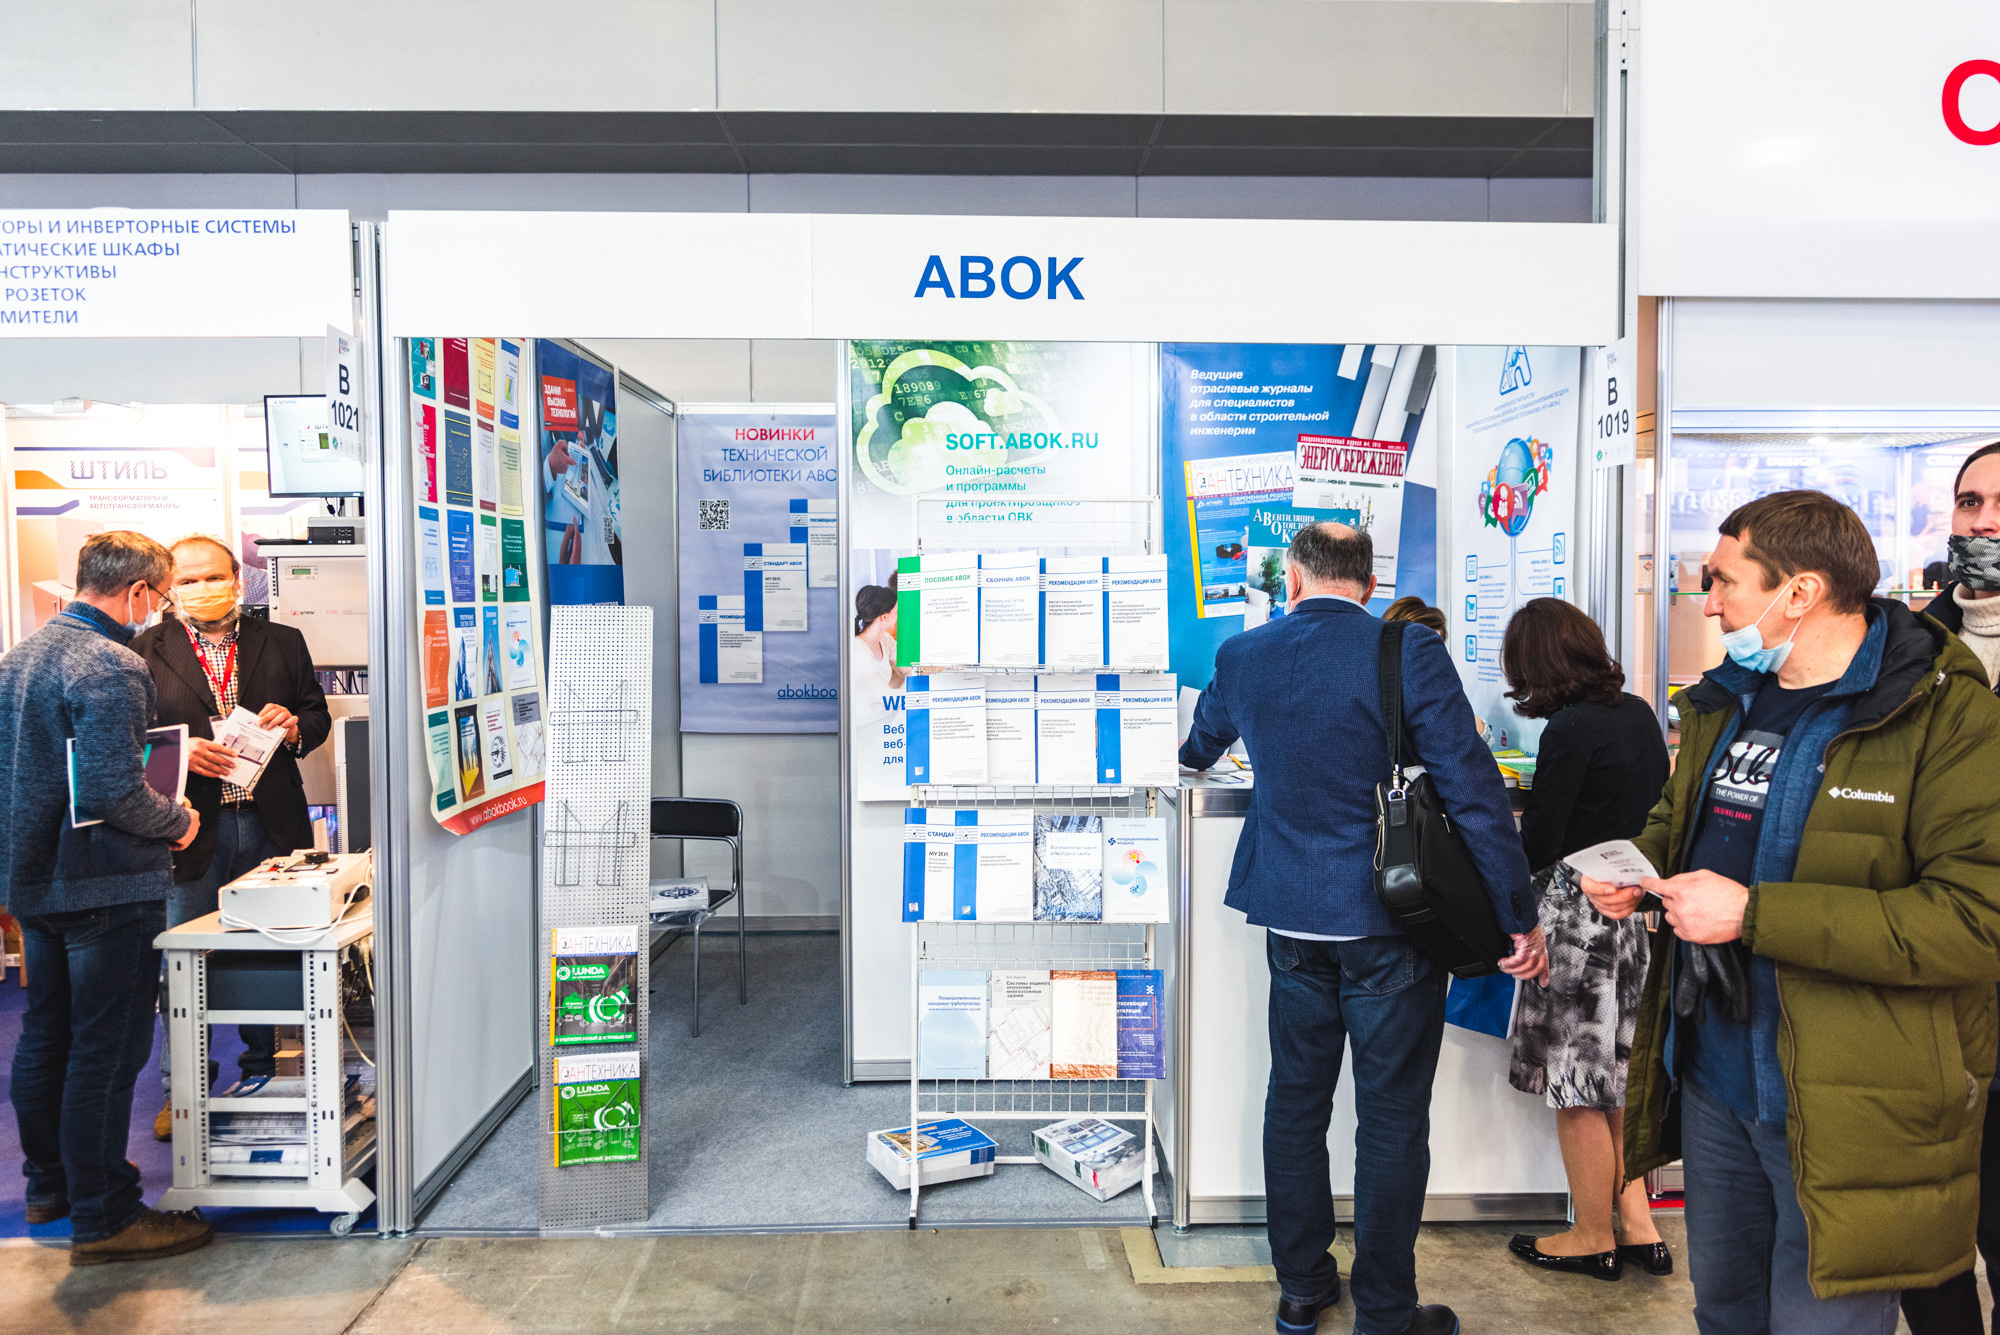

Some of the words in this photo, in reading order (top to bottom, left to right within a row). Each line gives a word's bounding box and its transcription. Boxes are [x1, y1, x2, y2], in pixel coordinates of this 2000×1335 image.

[0, 220, 42, 234] ОРЫ
[48, 220, 61, 234] И
[66, 219, 200, 234] ИНВЕРТОРНЫЕ
[205, 219, 297, 234] СИСТЕМЫ
[0, 242, 97, 256] ТИЧЕСКИЕ
[102, 241, 180, 257] ШКАФЫ
[914, 254, 1085, 300] АВОК
[5, 287, 87, 301] РОЗЕТОК
[0, 310, 79, 324] МИТЕЛИ
[1190, 369, 1243, 383] Ведущие
[1190, 384, 1259, 395] отраслевые
[1261, 384, 1313, 395] журналы
[1189, 399, 1212, 409] для
[1214, 397, 1295, 410] специалистов
[331, 399, 359, 432] 1021
[1190, 413, 1198, 421] в
[1199, 410, 1247, 422] области
[1249, 410, 1329, 423] строительной
[1597, 408, 1629, 439] 1019
[734, 428, 815, 441] НОВИНКИ
[1190, 425, 1256, 437] инженерии
[946, 432, 1099, 451] SOFT.ABOK.RU
[721, 446, 828, 462] ТЕХНИЧЕСКОЙ
[1299, 444, 1405, 477] ЭНЕРГОСБЕРЕЖЕНИЕ
[70, 459, 168, 480] ШТИЛЬ
[703, 469, 802, 483] БИБЛИОТЕКИ
[946, 464, 1046, 477] Онлайн-расчеты
[1195, 465, 1295, 495] САНТЕХНИКА
[956, 483, 1026, 493] программы
[883, 756, 904, 765] для
[1716, 788, 1726, 796] THE
[1727, 790, 1748, 801] POWER
[1840, 787, 1895, 804] Columbia
[469, 796, 528, 826] www.abokbook.ru
[1714, 806, 1734, 818] ORIGINAL
[1735, 811, 1752, 821] BRAND
[558, 935, 633, 954] САНТЕХНИКА
[572, 966, 605, 976] LUNDA
[560, 1063, 637, 1083] САНТЕХНИКА
[577, 1084, 610, 1094] LUNDA
